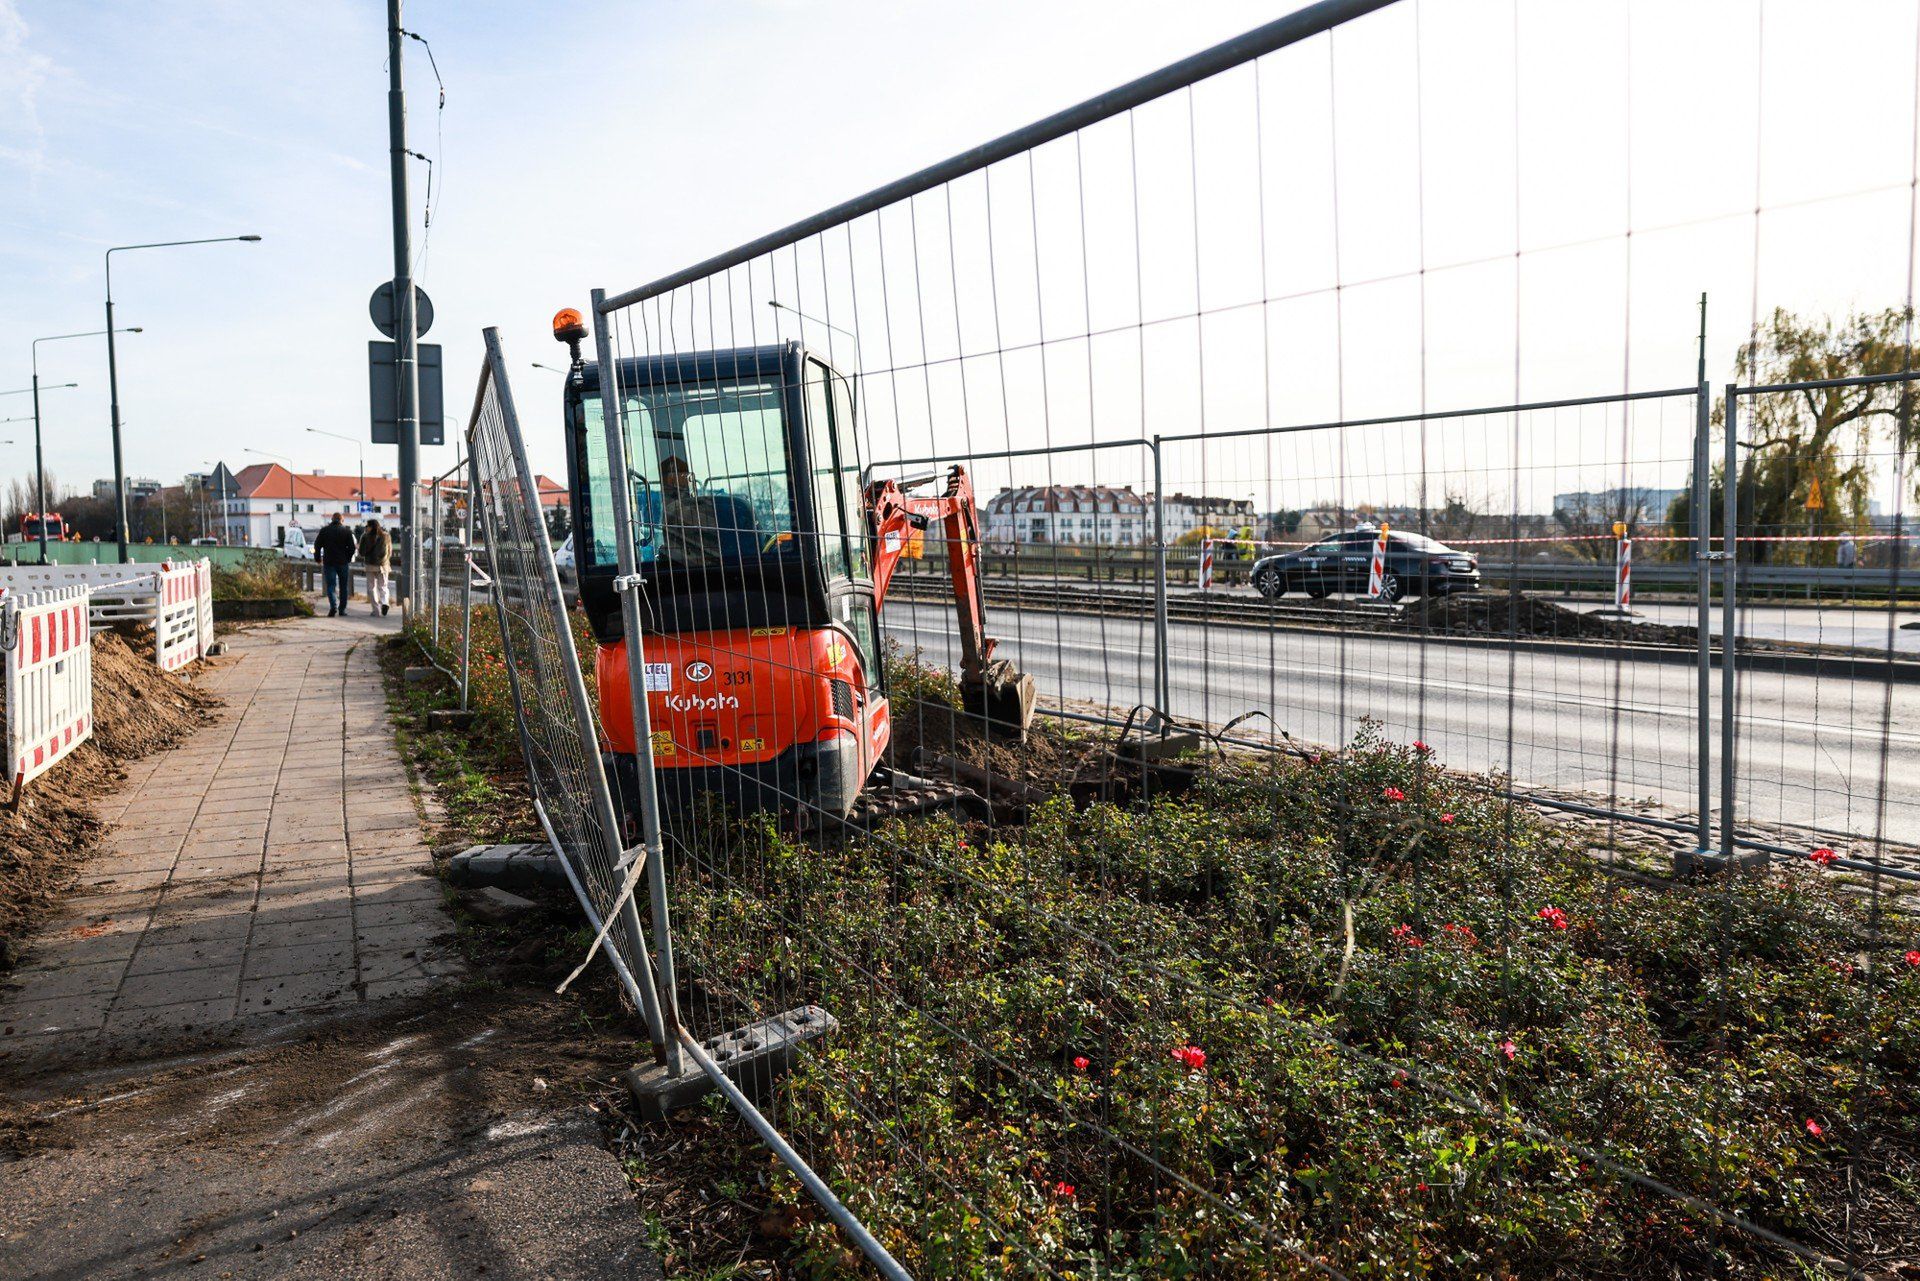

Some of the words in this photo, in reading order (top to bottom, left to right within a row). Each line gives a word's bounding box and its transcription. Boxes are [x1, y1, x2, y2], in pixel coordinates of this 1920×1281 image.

[645, 664, 667, 675] LTEL
[723, 670, 752, 686] 3131
[665, 693, 739, 712] Kubota
